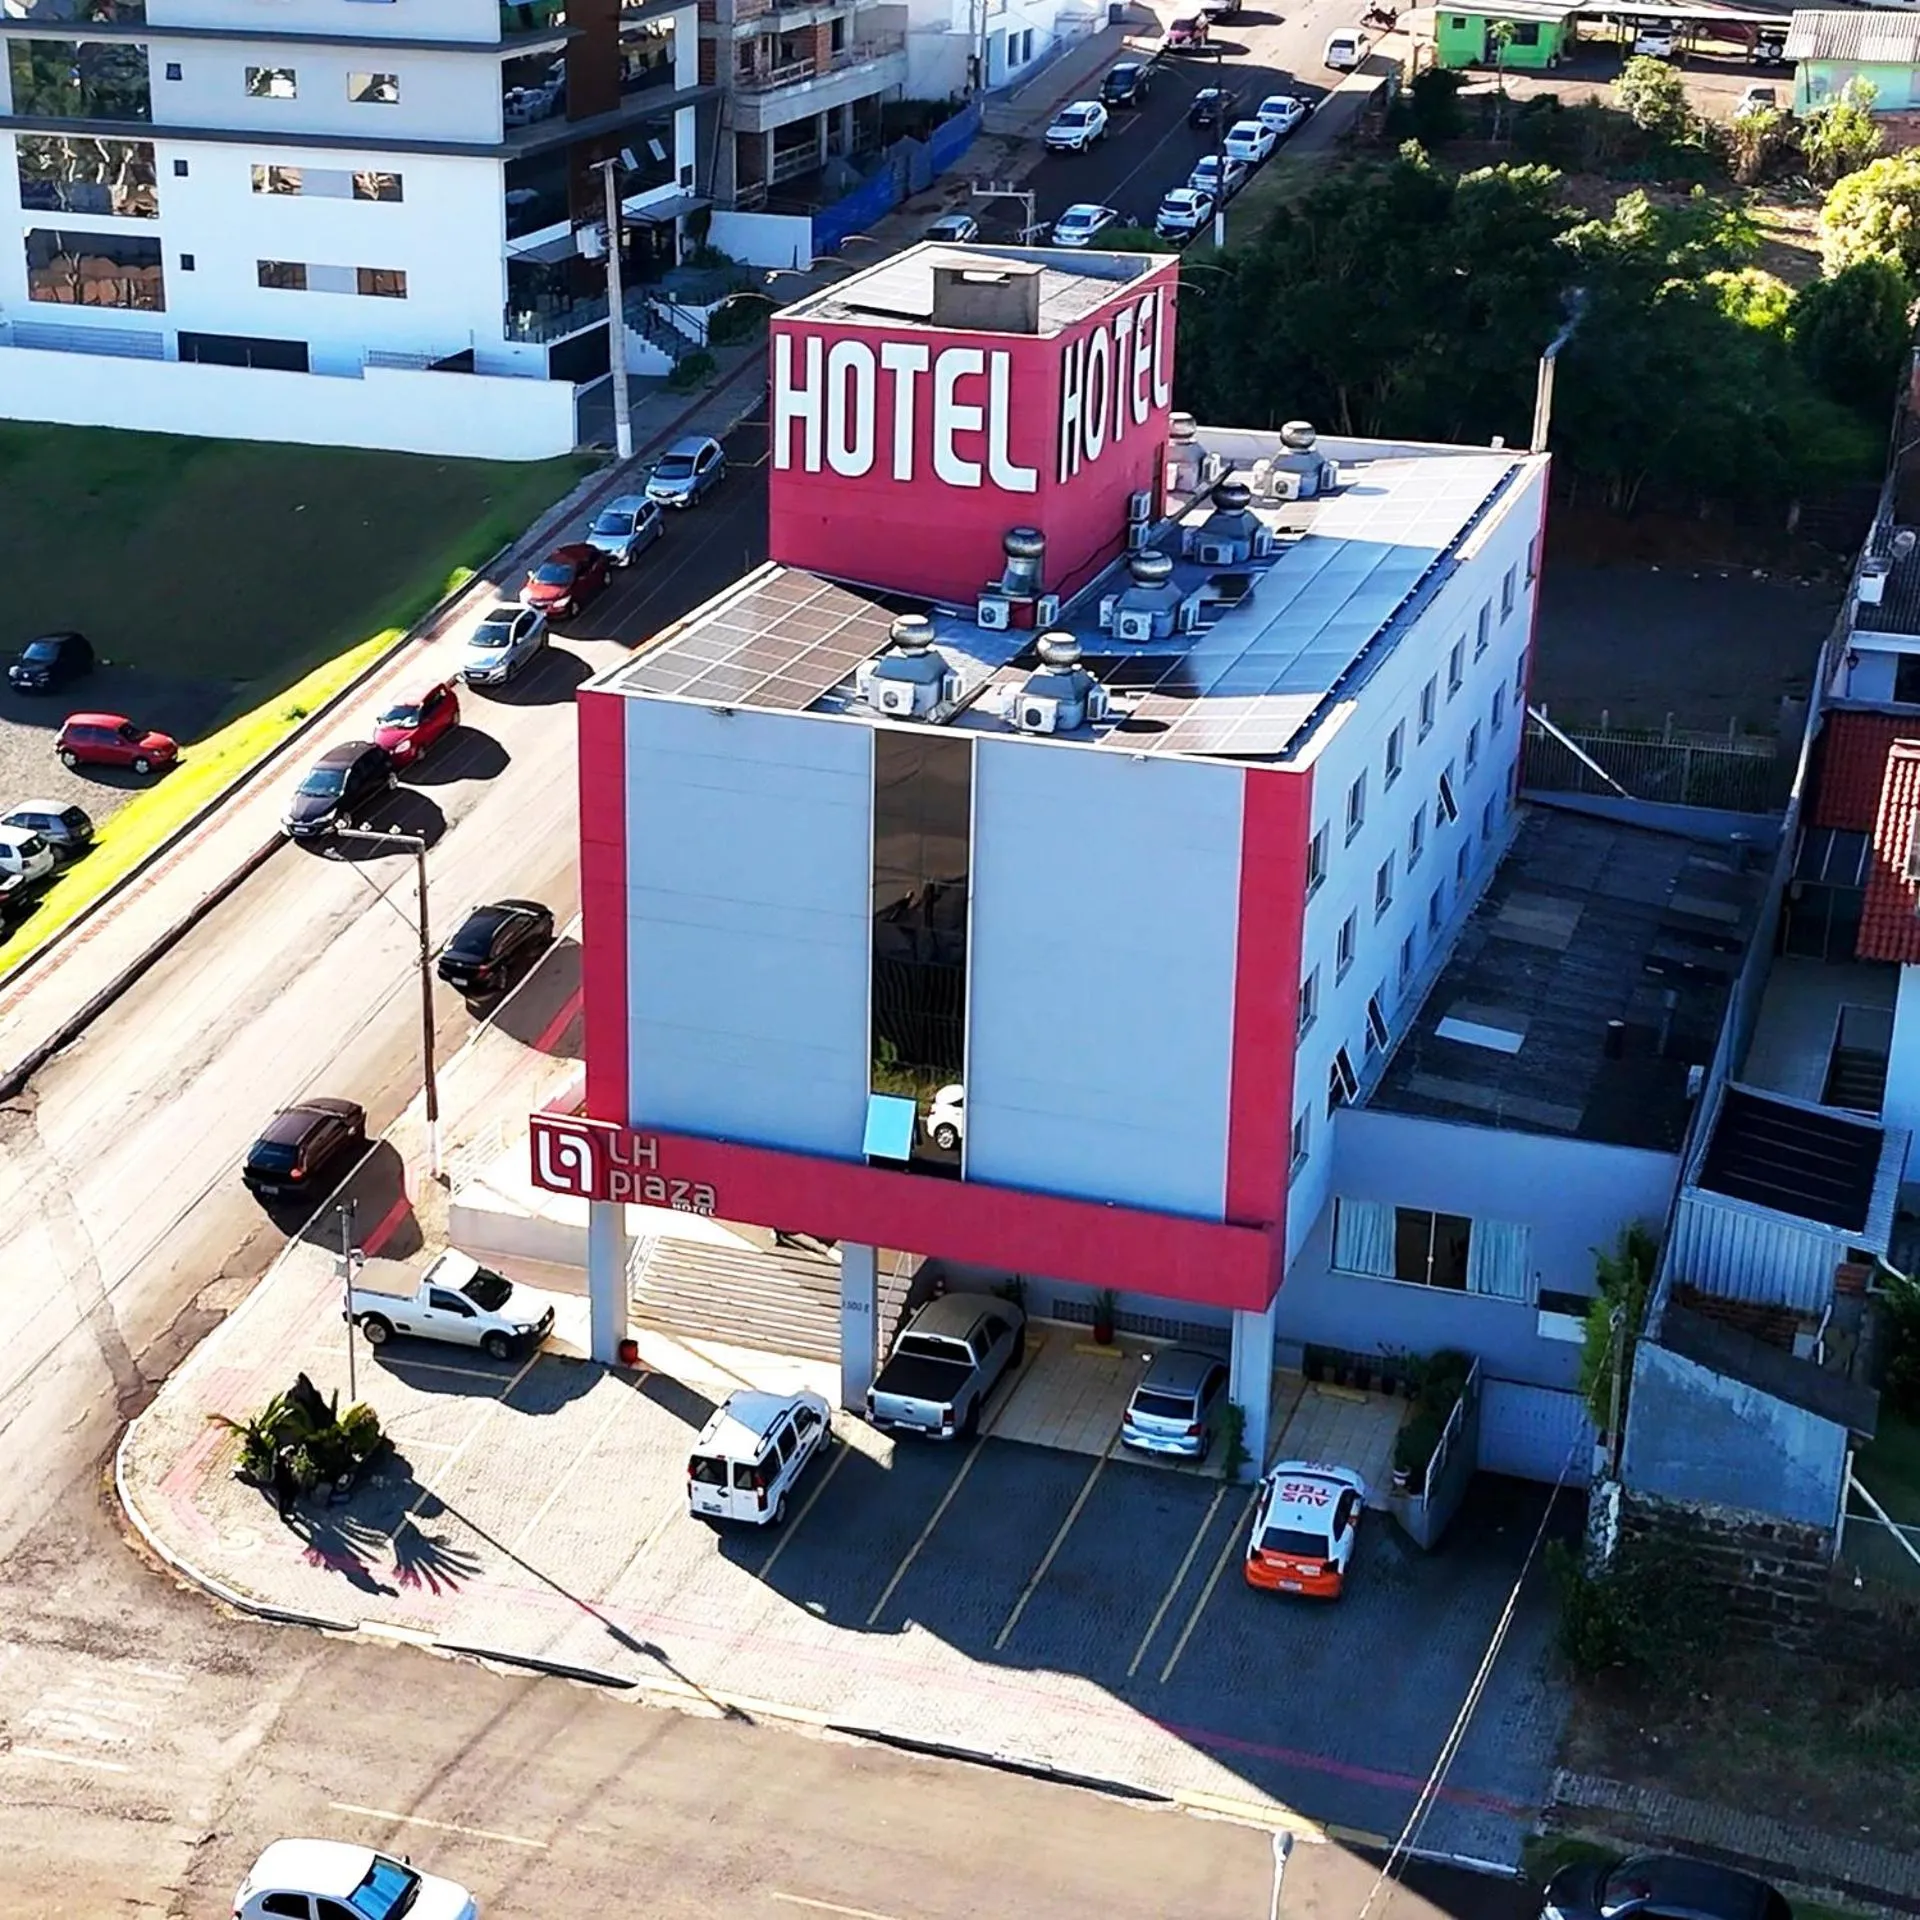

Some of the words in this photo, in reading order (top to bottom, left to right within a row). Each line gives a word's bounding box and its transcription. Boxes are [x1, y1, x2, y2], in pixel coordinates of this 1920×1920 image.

[1058, 286, 1169, 484] HOTEL
[774, 333, 1039, 493] HOTEL
[609, 1132, 657, 1169] LH
[671, 1201, 716, 1217] HOTEL
[1281, 1491, 1330, 1507] AUS
[1284, 1482, 1332, 1498] TER
